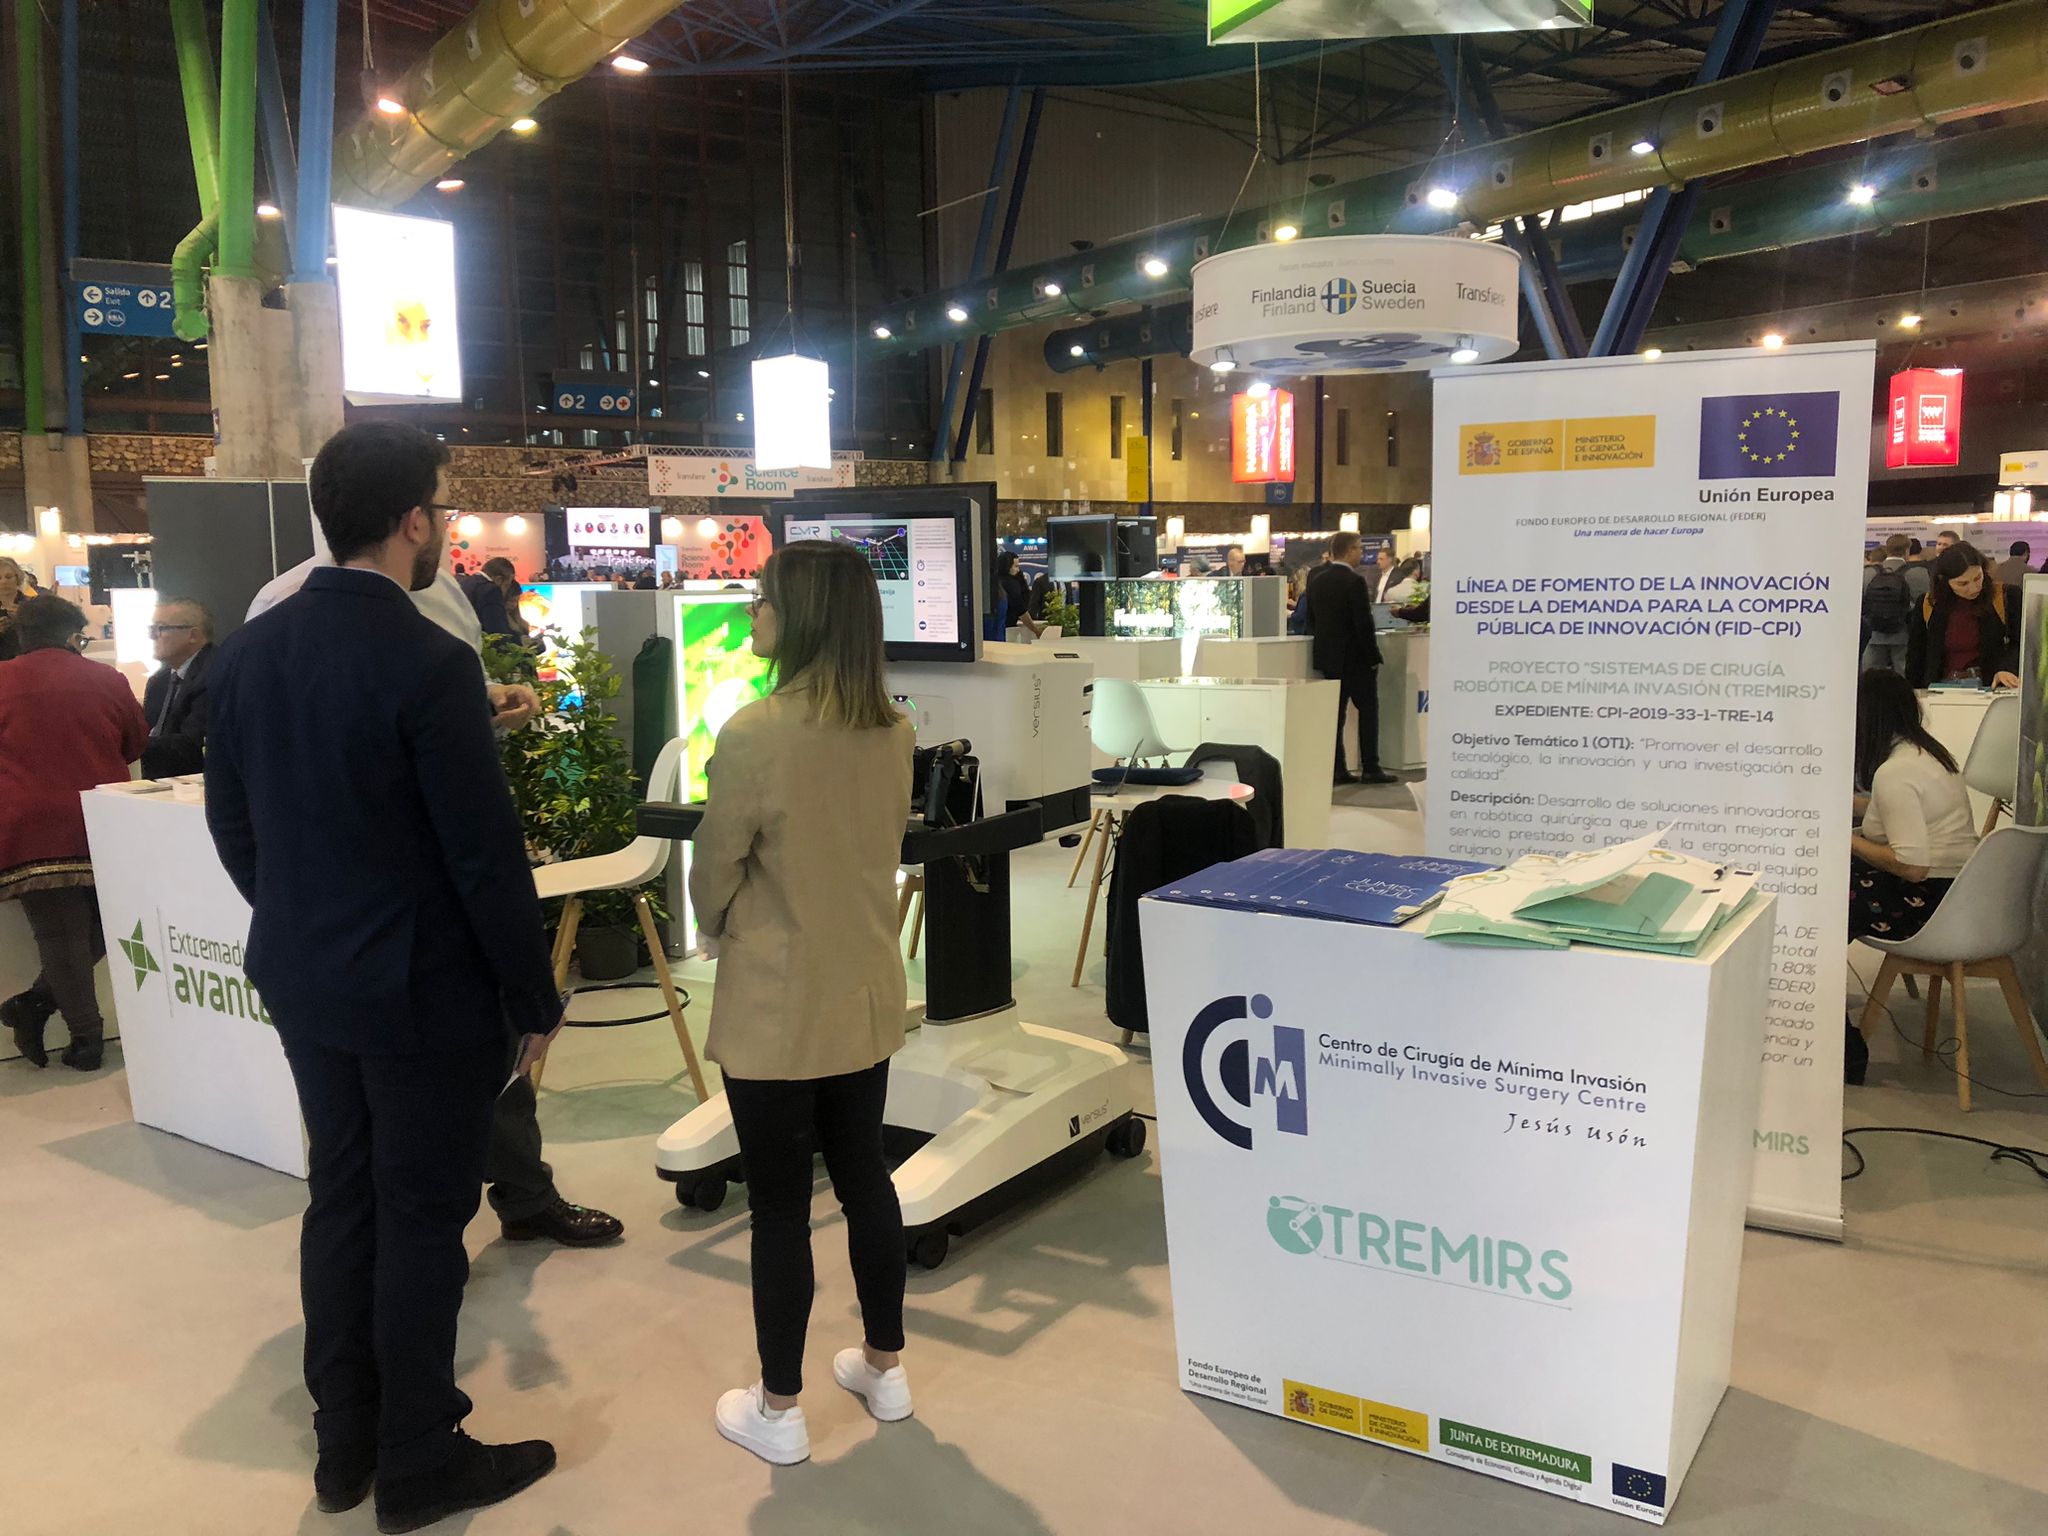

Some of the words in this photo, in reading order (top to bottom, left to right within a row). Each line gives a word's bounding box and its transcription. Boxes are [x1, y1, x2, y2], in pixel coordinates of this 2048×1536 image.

[104, 287, 131, 296] Salida
[1251, 284, 1316, 303] Finlandia
[1362, 280, 1416, 294] Suecia
[159, 291, 171, 309] 2
[1362, 295, 1425, 310] Sweden
[1263, 300, 1316, 317] Finland
[575, 394, 586, 409] 2
[1507, 437, 1553, 447] GOBIERNO
[1575, 434, 1625, 444] MINISTERIO
[1507, 448, 1519, 456] DE
[1520, 446, 1554, 456] ESPAÑA
[1575, 445, 1587, 453] DE
[1589, 444, 1626, 452] CIENCIA
[1582, 451, 1643, 462] INNOVACIÓN
[746, 478, 787, 491] Room
[1699, 488, 1750, 503] Unión
[1757, 488, 1835, 504] Europea
[1515, 518, 1549, 527] FONDO
[1551, 516, 1596, 526] EUROPEO
[1598, 515, 1611, 525] DE
[1613, 514, 1675, 524] DESARROLLO
[1678, 513, 1728, 523] REGIONAL
[1730, 511, 1766, 522] (FEDER)
[1573, 529, 1591, 537] Una
[1630, 528, 1641, 537] de
[1644, 527, 1669, 536] hacer
[1671, 526, 1704, 537] Europa
[1457, 576, 1508, 593] LÍNEA
[1513, 579, 1536, 592] DE
[1541, 577, 1635, 592] FOMENTO
[1640, 577, 1665, 591] DE
[1670, 577, 1696, 590] LA
[1701, 572, 1830, 591] INNOVACIÓN
[1456, 600, 1514, 614] DESDE
[1518, 600, 1543, 614] LA
[1547, 599, 1643, 614] DEMANDA
[1648, 599, 1703, 613] PARA
[1708, 599, 1734, 613] LA
[1739, 598, 1829, 613] COMPRA
[1477, 618, 1555, 635] PÚBLICA
[1560, 621, 1584, 635] DE
[1588, 617, 1710, 635] INNOVACIÓN
[1715, 620, 1801, 637] (FID-CPI)
[1489, 661, 1580, 674] PROYECTO
[1683, 662, 1706, 676] DE
[1710, 661, 1785, 677] CIRUGÍA
[1454, 677, 1537, 693] ROBÓTICA
[1541, 681, 1563, 694] DE
[1567, 678, 1630, 695] MÍNIMA
[1634, 680, 1720, 696] INVASIÓN
[1495, 705, 1594, 718] EXPEDIENTE:
[1597, 706, 1774, 723] CPI-2019-33-1-TRE-14
[1452, 733, 1510, 748] Objetivo
[1515, 734, 1579, 748] Temático
[1582, 736, 1589, 748] 1
[1725, 741, 1739, 753] el
[1744, 742, 1823, 757] desarrollo
[1452, 751, 1532, 768] tecnológico,
[1539, 752, 1552, 765] la
[1558, 753, 1636, 768] innovación
[1643, 760, 1652, 771] y
[1659, 760, 1687, 770] una
[1694, 758, 1794, 777] investigación
[1801, 763, 1822, 776] de
[1450, 790, 1535, 806] Descripción:
[1537, 794, 1612, 810] Desarrollo
[1616, 798, 1636, 810] de
[1641, 800, 1719, 815] soluciones
[1724, 803, 1821, 820] innovadoras
[1450, 809, 1467, 820] en
[1474, 808, 1533, 823] robótica
[1540, 812, 1612, 831] quirúrgica
[1619, 818, 1648, 830] que
[1735, 824, 1798, 839] mejorar
[1806, 826, 1820, 839] el
[1449, 824, 1501, 839] servicio
[1508, 828, 1575, 842] prestado
[1582, 831, 1596, 844] al
[1680, 838, 1694, 850] la
[1702, 839, 1786, 857] ergonomía
[1794, 844, 1819, 858] del
[1449, 841, 1502, 857] cirujano
[1507, 847, 1515, 858] y
[1764, 864, 1818, 878] equipo
[1761, 882, 1818, 896] calidad
[1795, 926, 1819, 940] DE
[168, 925, 246, 967] Extremad
[1782, 961, 1817, 976] 80%
[1794, 999, 1816, 1012] de
[1805, 1039, 1814, 1051] y
[1319, 1033, 1372, 1054] Centro
[1378, 1042, 1398, 1057] de
[1403, 1045, 1464, 1069] Cirugía
[1470, 1055, 1492, 1071] de
[1497, 1059, 1564, 1081] Mínima
[1571, 1069, 1647, 1094] Invasión
[1761, 1051, 1789, 1064] por
[1794, 1056, 1814, 1067] un
[1319, 1052, 1405, 1080] Minimally
[1412, 1065, 1487, 1090] Invasive
[1495, 1077, 1570, 1105] Surgery
[1578, 1089, 1647, 1113] Centre
[1504, 1113, 1572, 1136] Jesús
[1321, 1204, 1573, 1301] TREMIRS
[1187, 1358, 1214, 1372] Fondo
[1215, 1365, 1249, 1380] Europeo
[1250, 1374, 1262, 1384] de
[1188, 1369, 1230, 1386] Desarrollo
[1230, 1379, 1267, 1396] Regional
[1318, 1400, 1354, 1414] GOBIERNO
[1318, 1407, 1329, 1415] DE
[1329, 1409, 1354, 1421] ESPAÑA
[1369, 1413, 1407, 1428] MINISTERIO
[1379, 1422, 1408, 1434] CIENCIA
[1374, 1428, 1421, 1444] INNOVACIÓN
[1449, 1428, 1484, 1447] JUNTA
[1485, 1437, 1499, 1451] DE
[1500, 1442, 1581, 1473] EXTREMADURA
[1476, 1456, 1483, 1465] de
[1514, 1466, 1535, 1479] Ciencia
[1541, 1474, 1562, 1486] Agenda
[1563, 1479, 1583, 1492] Digital
[1612, 1498, 1634, 1510] Unión
